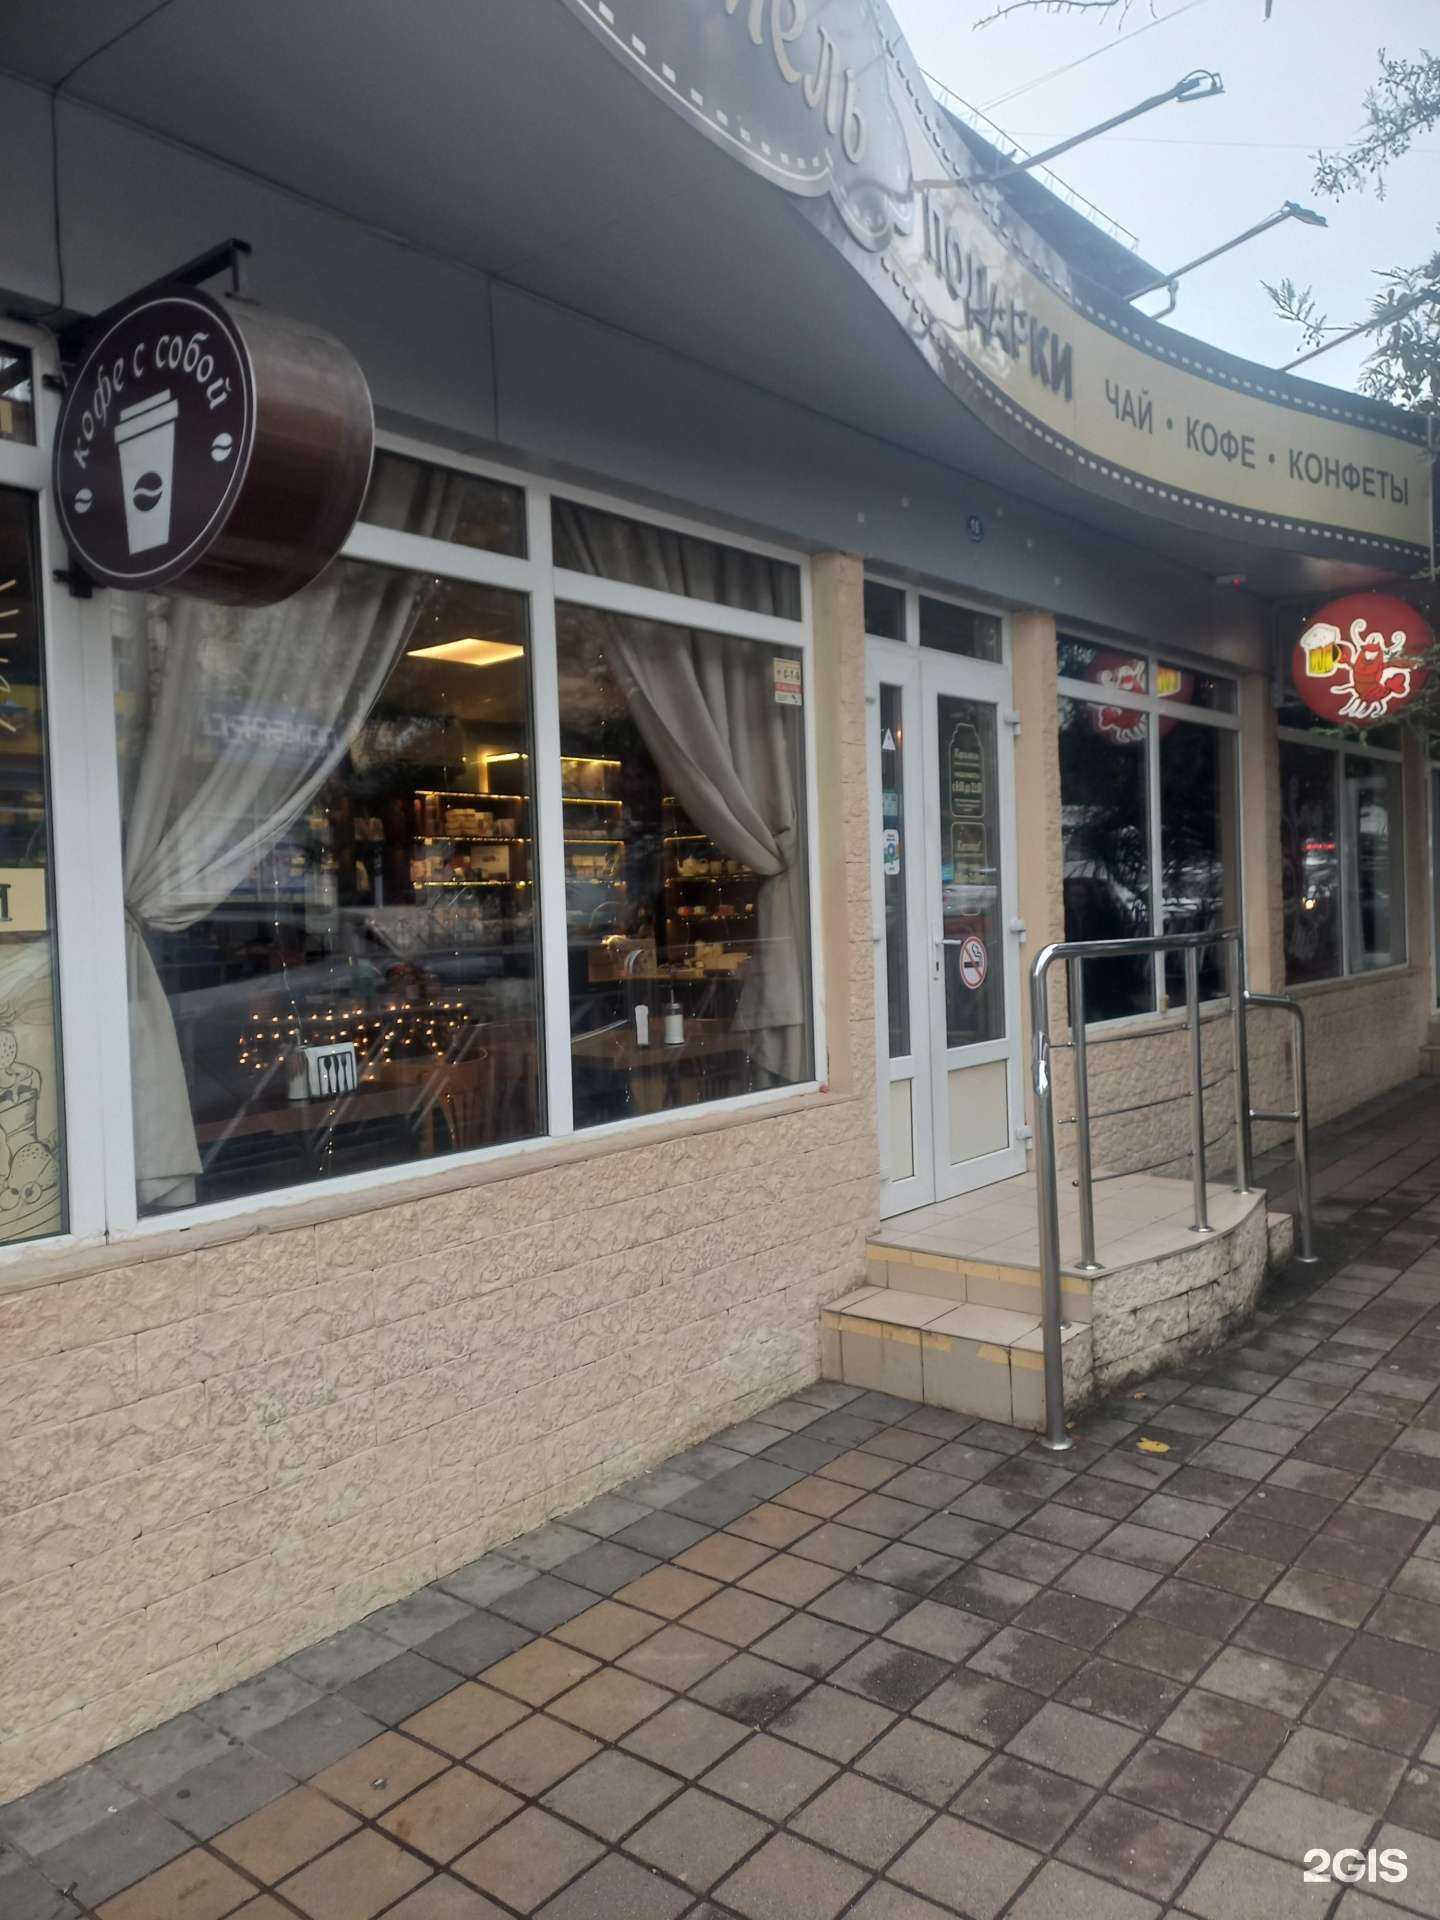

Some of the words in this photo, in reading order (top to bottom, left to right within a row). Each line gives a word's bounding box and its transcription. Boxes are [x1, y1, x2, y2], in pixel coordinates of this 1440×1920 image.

[75, 358, 125, 468] кофе
[133, 342, 145, 377] с
[156, 333, 232, 410] собой
[923, 189, 1073, 402] ПОДАРКИ
[1105, 379, 1153, 434] ЧАЙ
[1186, 416, 1256, 469] КОФЕ
[1288, 449, 1409, 506] КОНФЕТЫ
